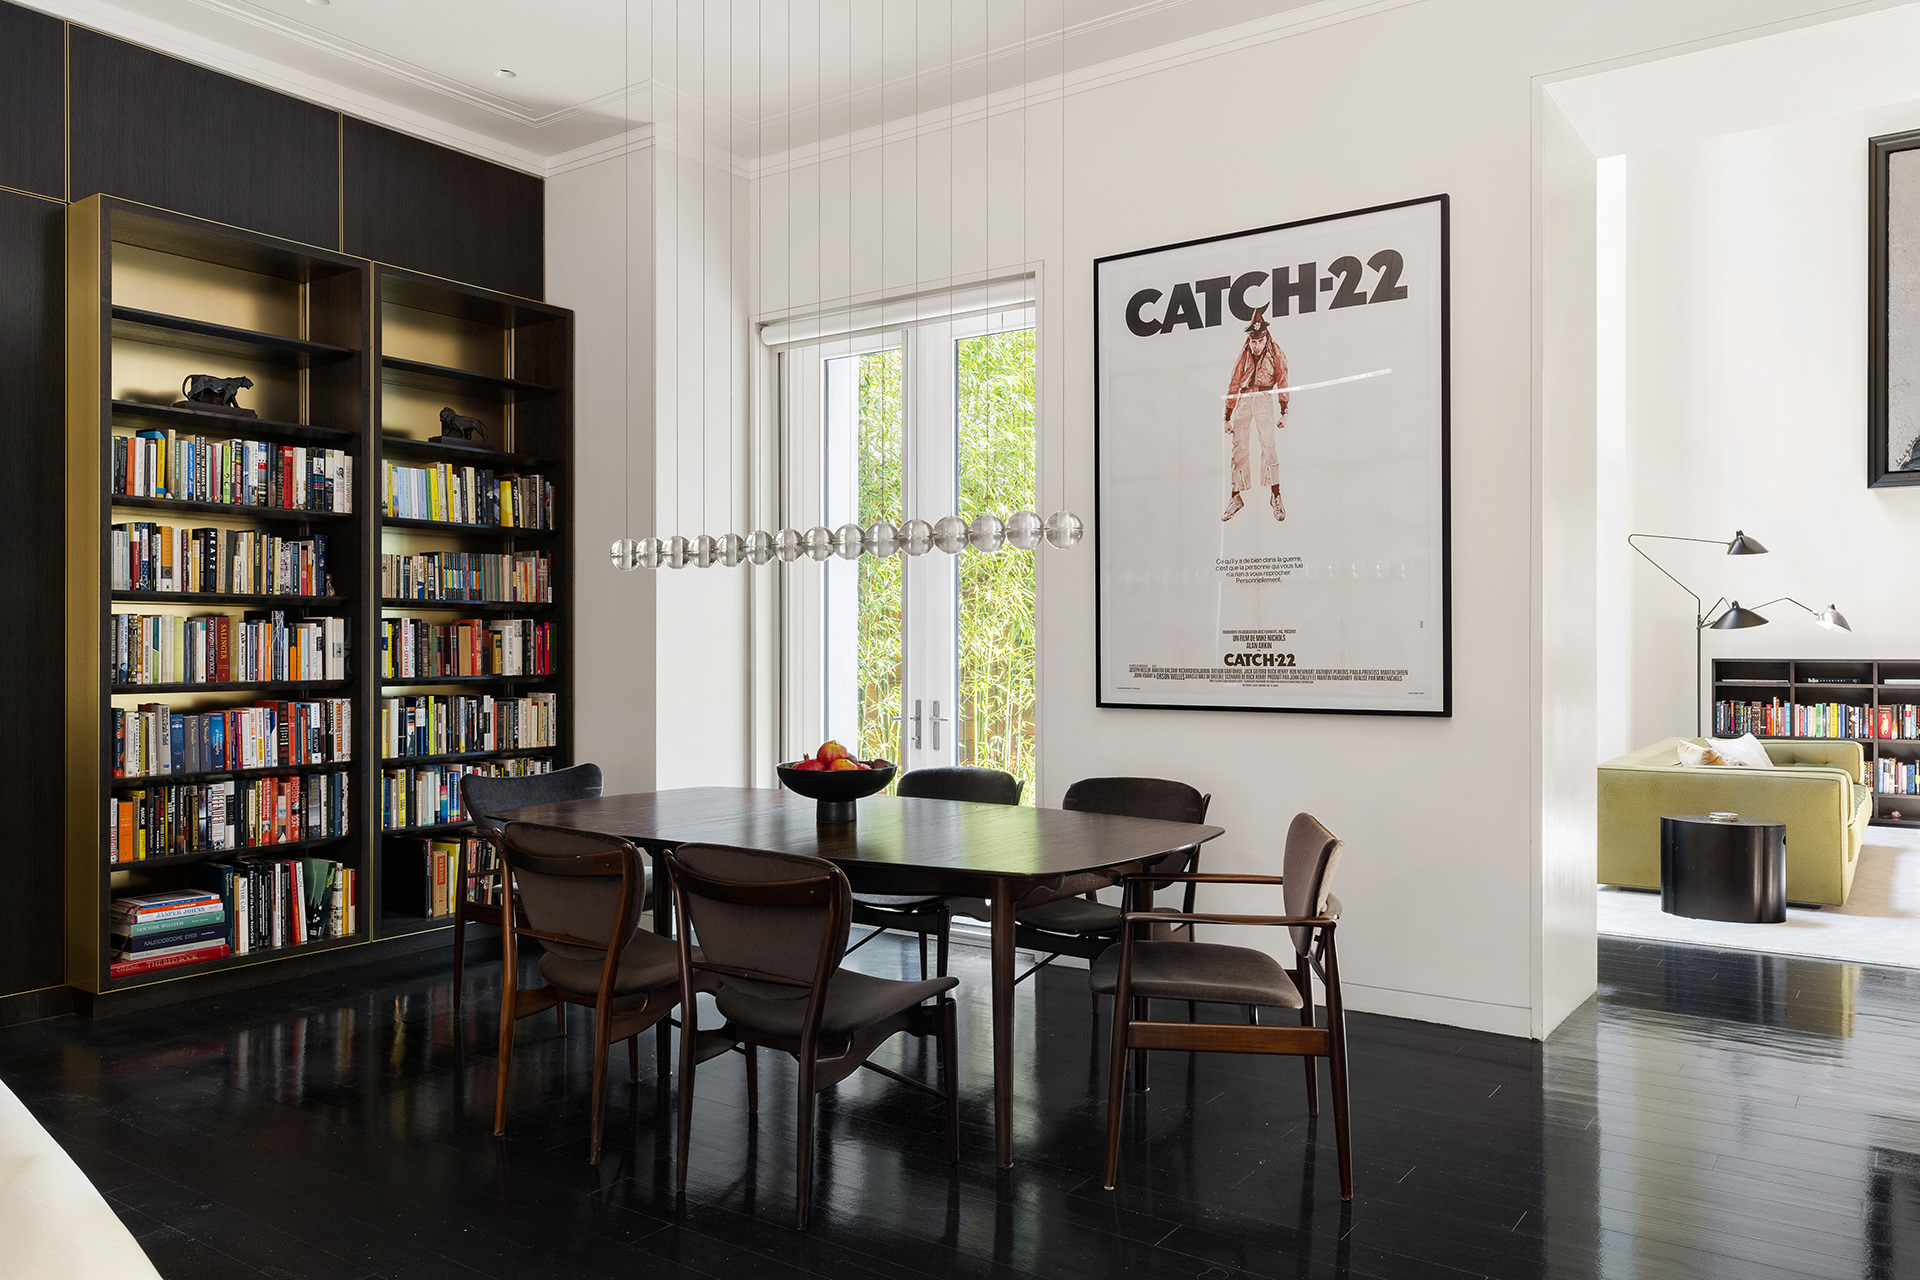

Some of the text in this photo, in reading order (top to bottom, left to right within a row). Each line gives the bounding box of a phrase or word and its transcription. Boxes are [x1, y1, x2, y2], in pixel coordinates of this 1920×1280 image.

[1125, 248, 1408, 338] CATCH-22
[1224, 653, 1296, 666] CATCH-22
[212, 790, 224, 824] DEFENDER
[156, 910, 181, 918] JASPER
[144, 936, 183, 946] KALEIDOSCOPE
[178, 955, 198, 963] BOOK
